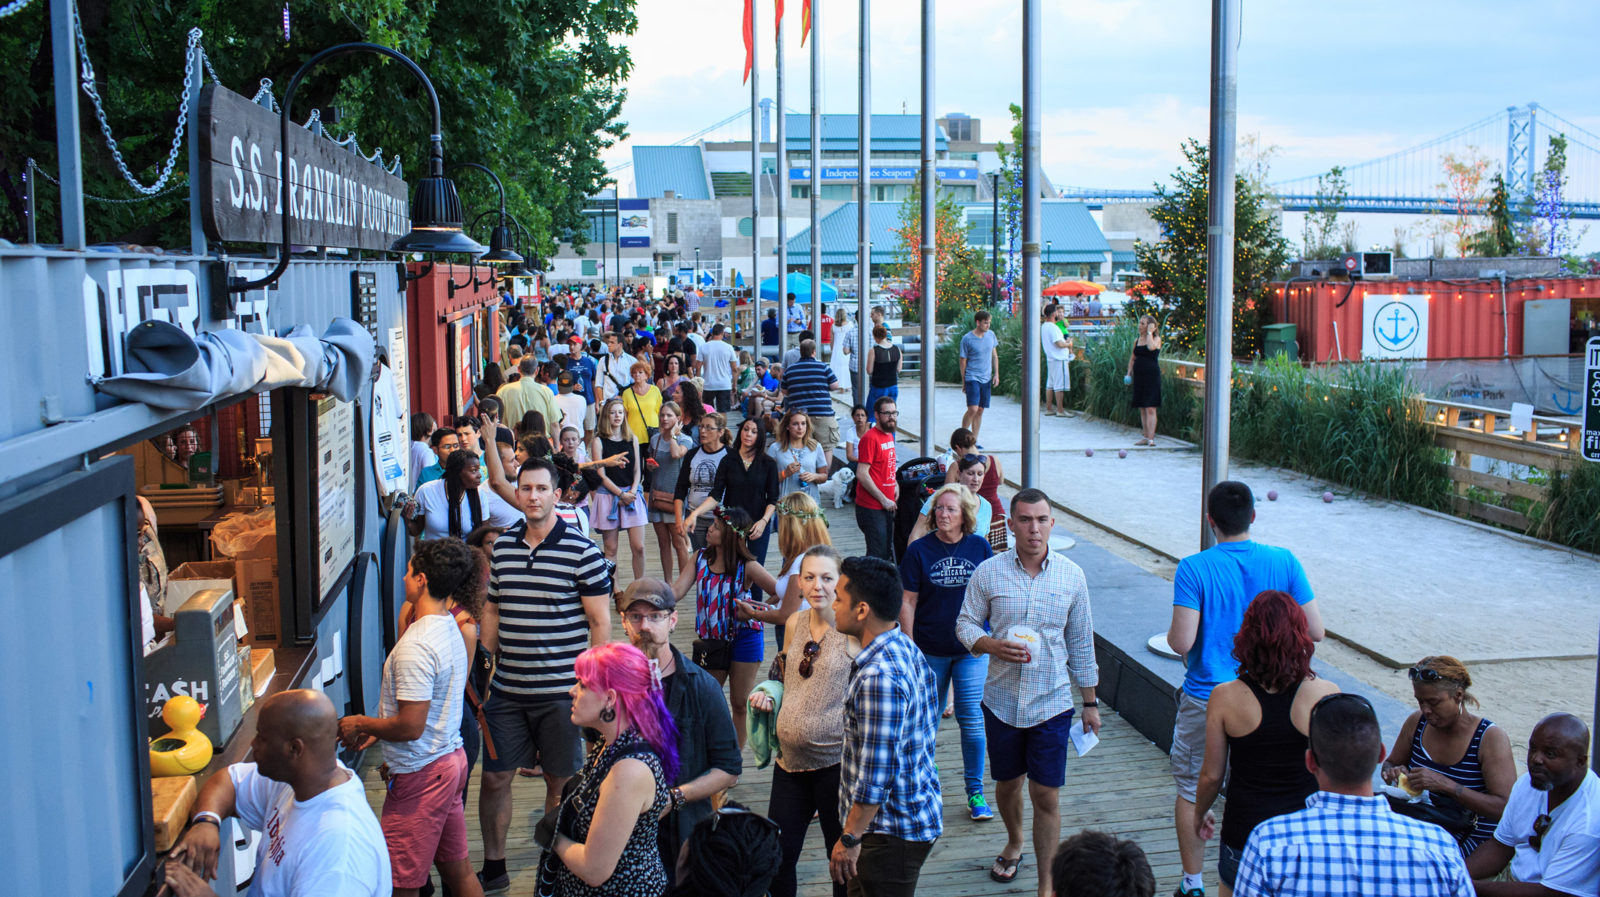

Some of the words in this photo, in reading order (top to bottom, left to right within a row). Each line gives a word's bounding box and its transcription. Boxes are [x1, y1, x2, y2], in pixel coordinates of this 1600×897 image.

[825, 168, 881, 179] Indepence
[881, 168, 912, 179] Seaport
[230, 135, 268, 212] S.S.
[361, 183, 407, 237] FOUNTAIN
[719, 287, 745, 298] EXIT
[1483, 389, 1505, 400] Park
[940, 569, 967, 577] CHICAGO
